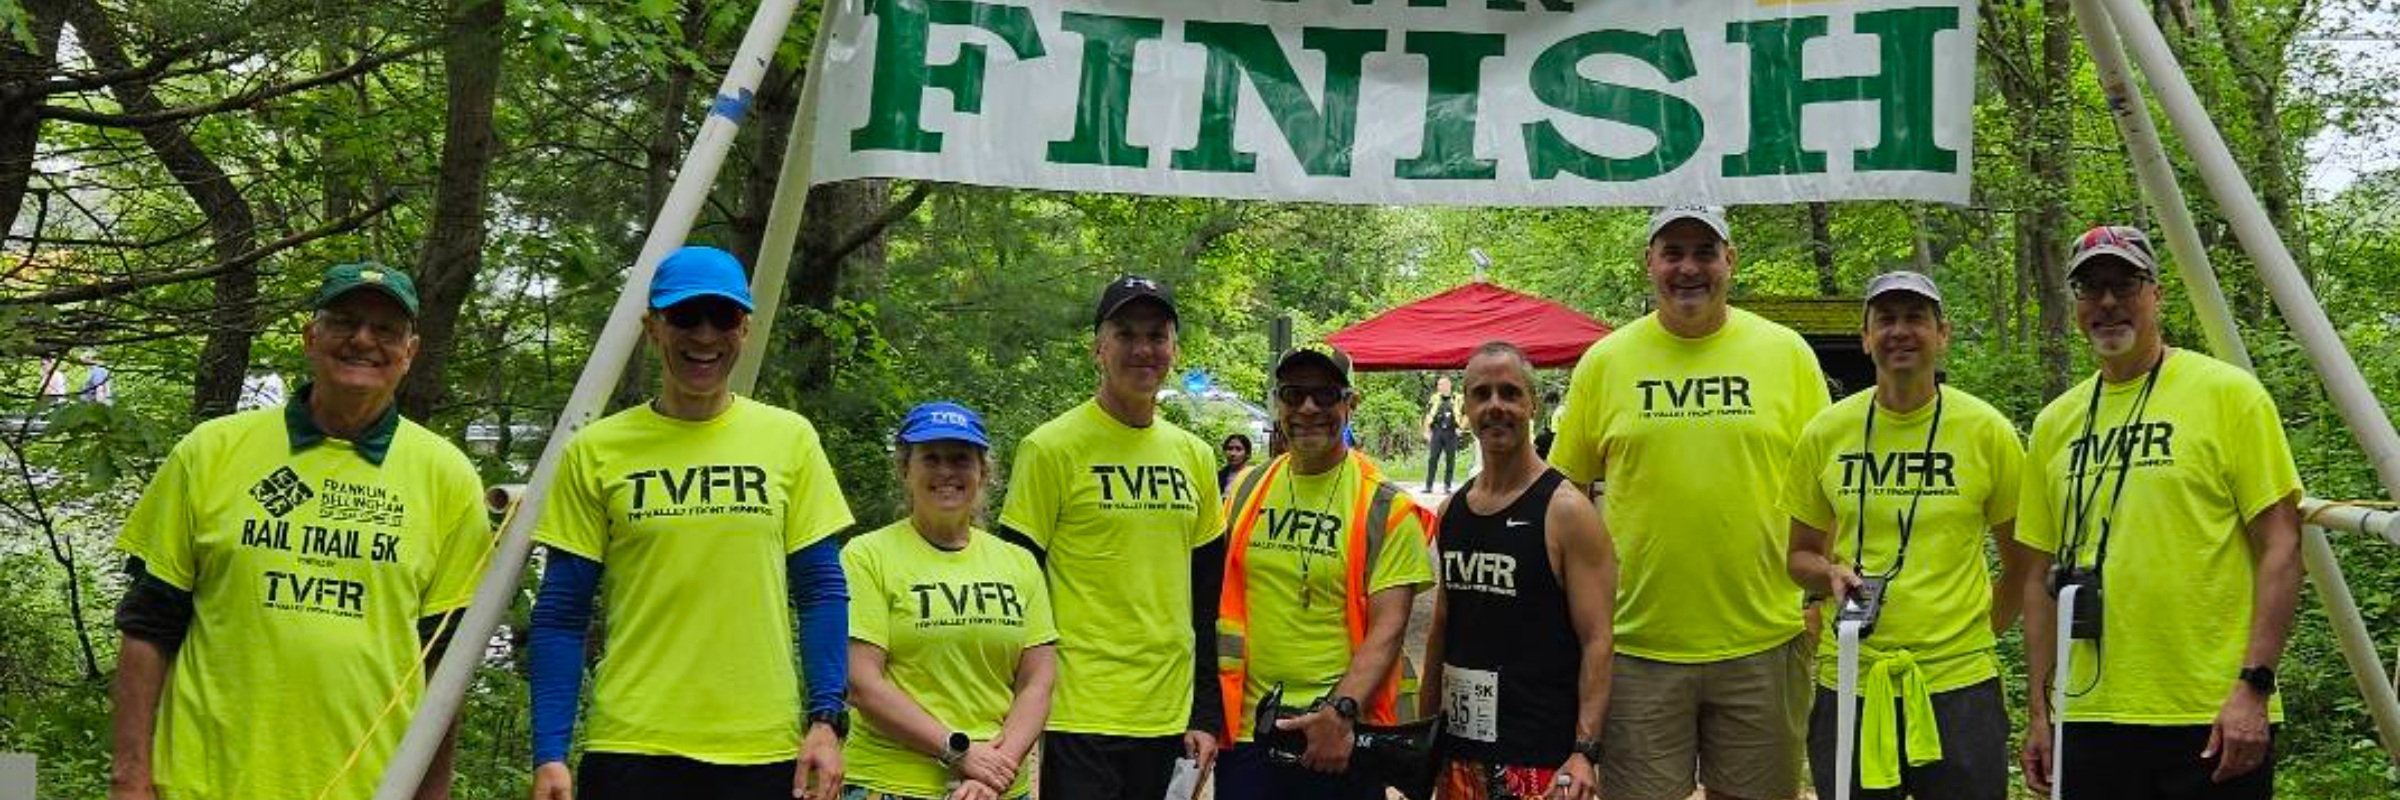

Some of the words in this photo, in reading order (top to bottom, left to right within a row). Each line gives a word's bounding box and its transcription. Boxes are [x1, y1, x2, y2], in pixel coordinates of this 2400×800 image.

[851, 0, 1958, 182] FINISH
[1636, 375, 1751, 411] TVFR
[930, 411, 968, 428] TVFR
[2068, 421, 2174, 472] TVFR
[626, 465, 769, 510] TVFR
[1091, 465, 1193, 502] TVFR
[1837, 452, 1955, 487] TVFR
[323, 478, 386, 500] FRANKLIN
[241, 519, 292, 551] RAIL
[301, 525, 363, 559] TRAIL
[371, 532, 400, 563] 5K
[1443, 550, 1517, 589] TVFR
[263, 571, 364, 612] TVFR
[910, 581, 1025, 619] TVFR
[1475, 684, 1495, 698] 5K
